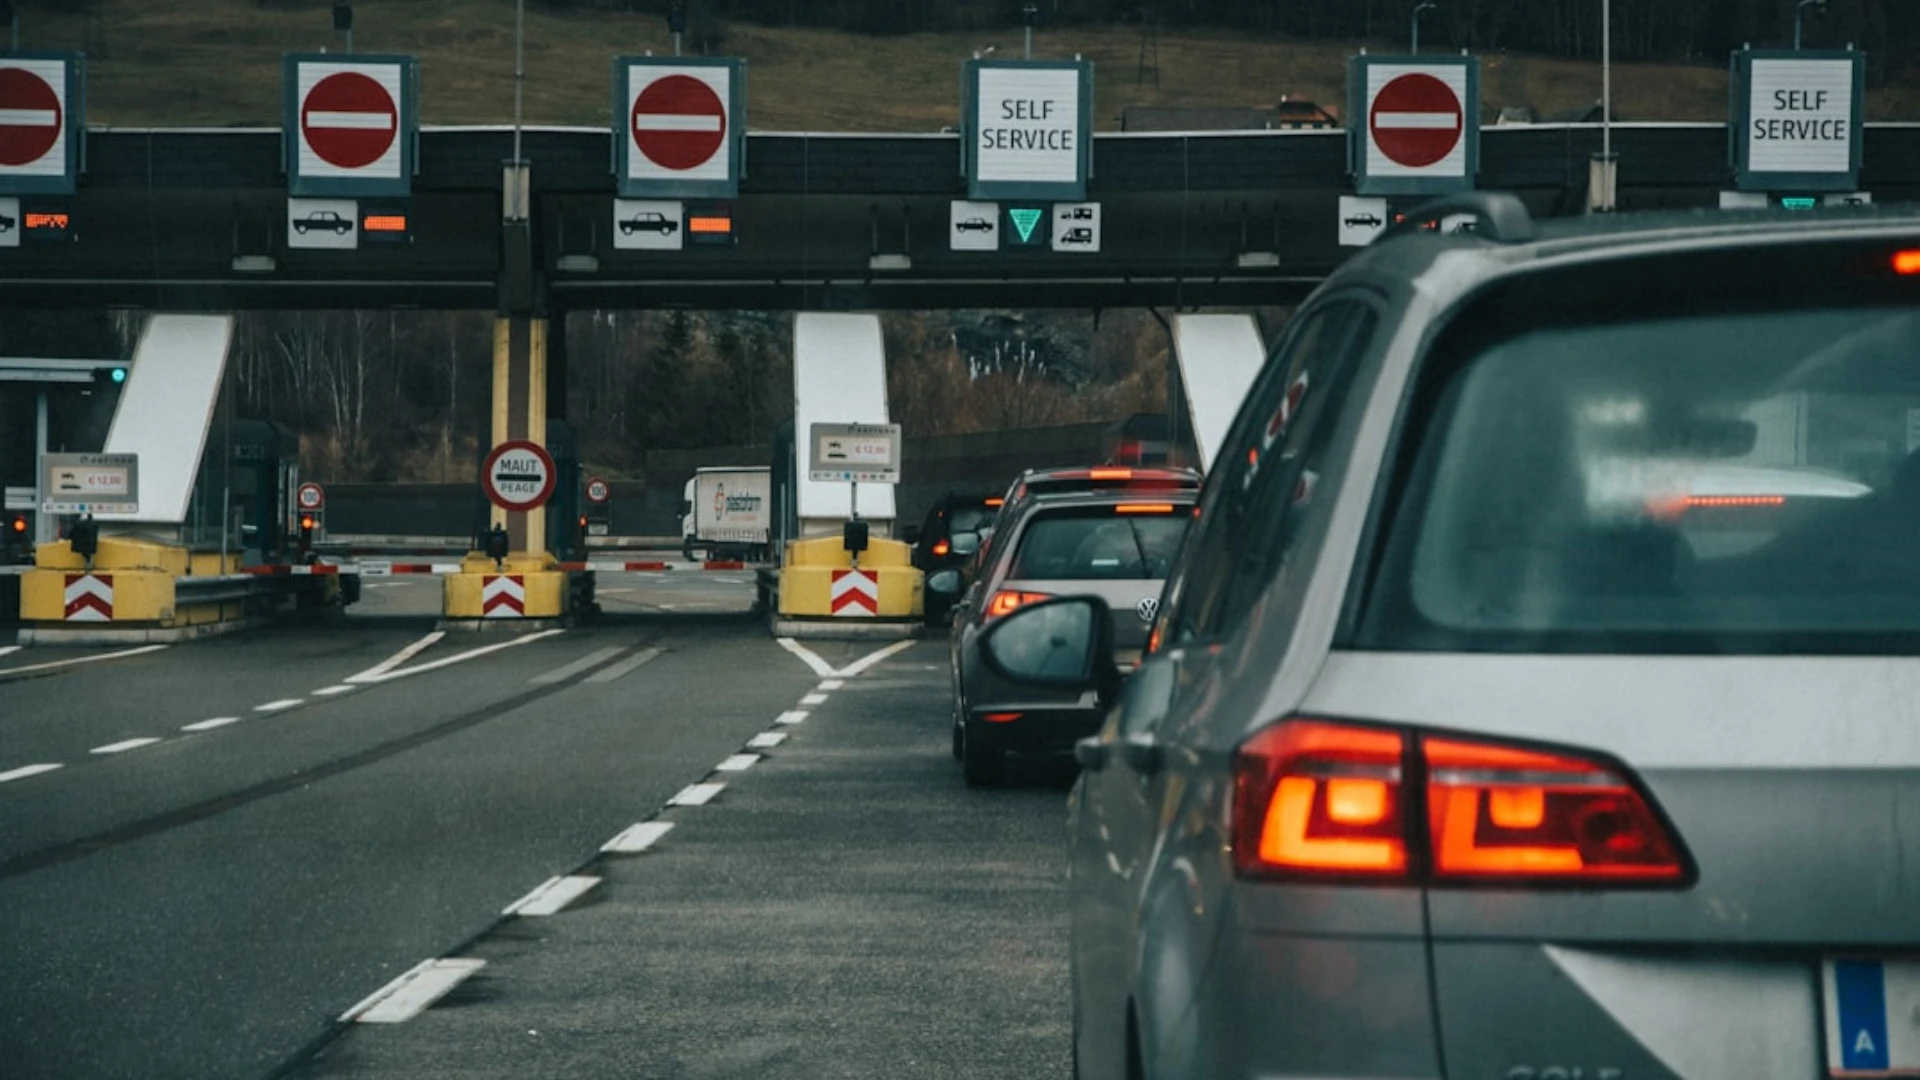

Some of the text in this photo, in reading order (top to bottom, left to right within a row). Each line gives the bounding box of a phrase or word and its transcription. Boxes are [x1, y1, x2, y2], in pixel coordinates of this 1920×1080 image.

[1001, 99, 1054, 119] SELF
[1774, 89, 1828, 110] SELF
[982, 128, 1073, 150] SERVICE
[1753, 118, 1846, 140] SERVICE
[500, 459, 537, 473] MAUT
[500, 482, 536, 493] PEAGE
[1854, 1028, 1876, 1053] A
